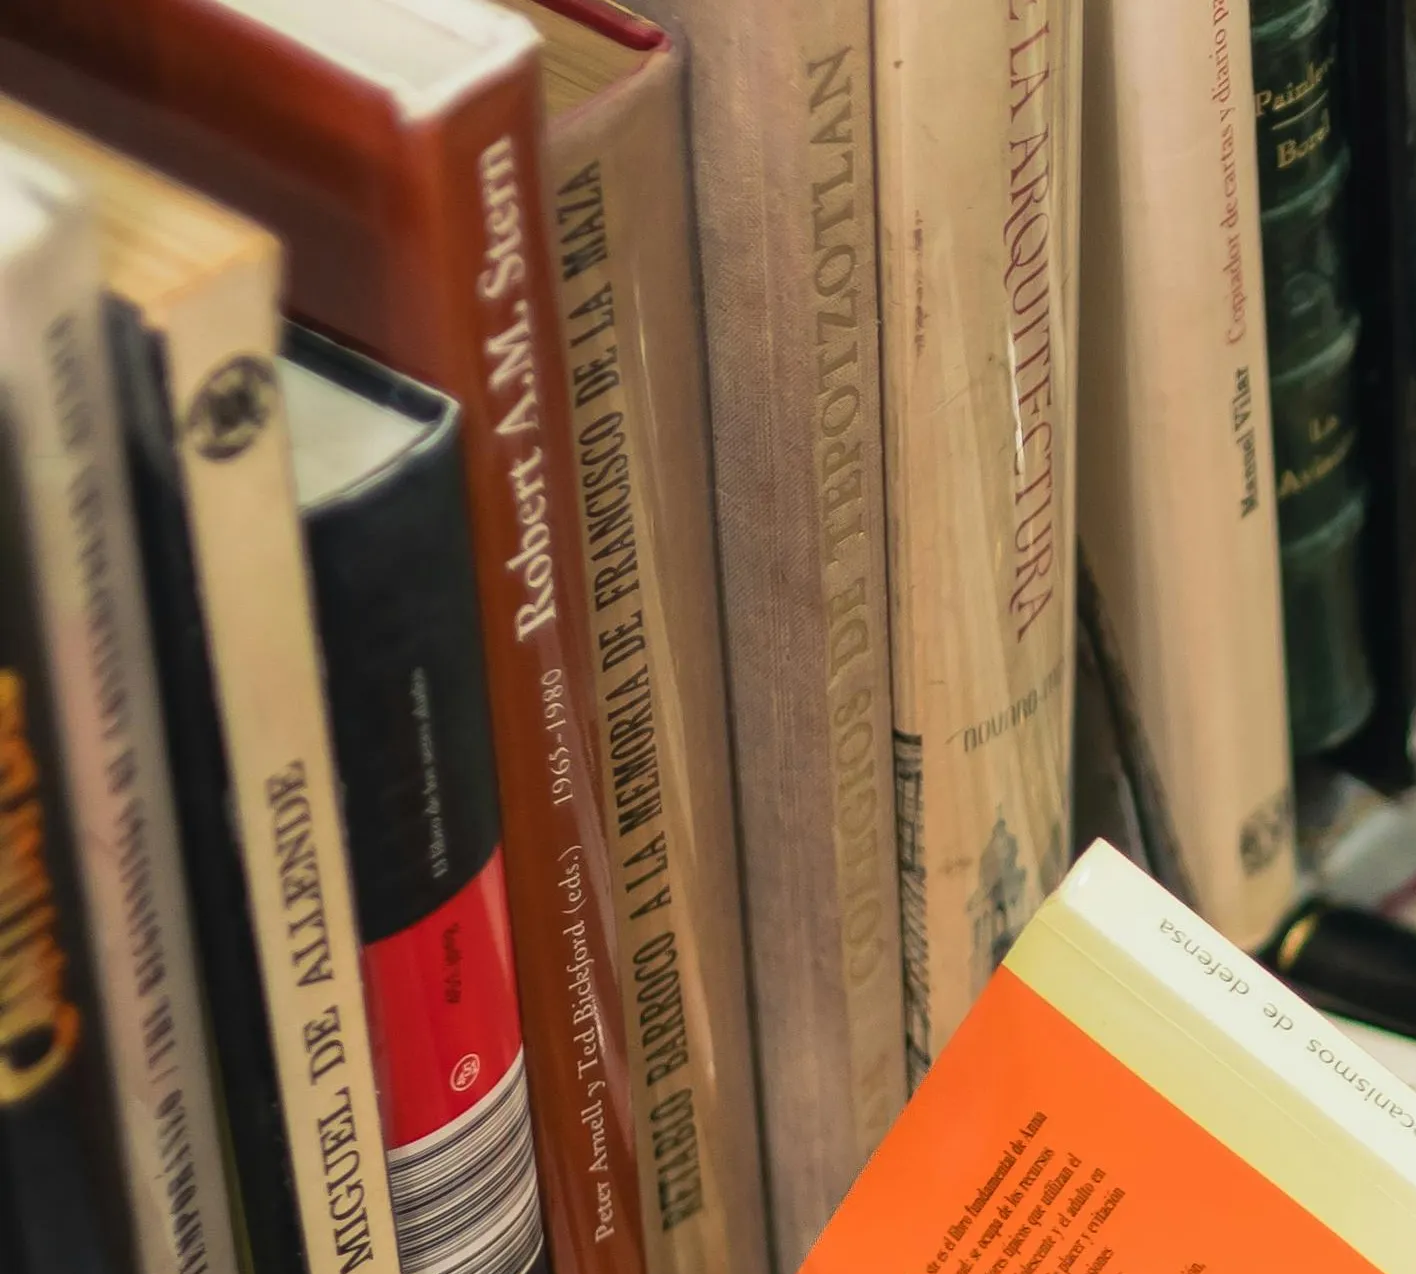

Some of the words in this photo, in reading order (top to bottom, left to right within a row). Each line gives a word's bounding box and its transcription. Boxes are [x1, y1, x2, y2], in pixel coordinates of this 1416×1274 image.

[1008, 22, 1053, 124] LA
[1208, 26, 1233, 103] diario
[476, 138, 524, 299] Stern
[556, 160, 609, 282] MAZA
[569, 281, 615, 349] LA
[484, 300, 539, 437] A.M.
[573, 345, 621, 409] DE
[1002, 130, 1057, 644] ARQUITECTURA
[505, 446, 556, 641] Robert
[578, 409, 642, 612] FRANCISCO
[600, 609, 648, 673] DE
[541, 668, 574, 806] 1965-1980
[605, 663, 663, 838] MEMORIA
[266, 759, 339, 988] ALLENDE
[557, 845, 588, 914] (eds.)
[623, 831, 668, 893] LA
[562, 919, 597, 1024] Bickford
[632, 931, 689, 1087] BARROCO
[1152, 917, 1252, 1002] defensa
[300, 1003, 346, 1088] DE
[573, 1030, 598, 1080] Ted
[1256, 1000, 1296, 1037] de
[594, 1182, 615, 1243] Peter
